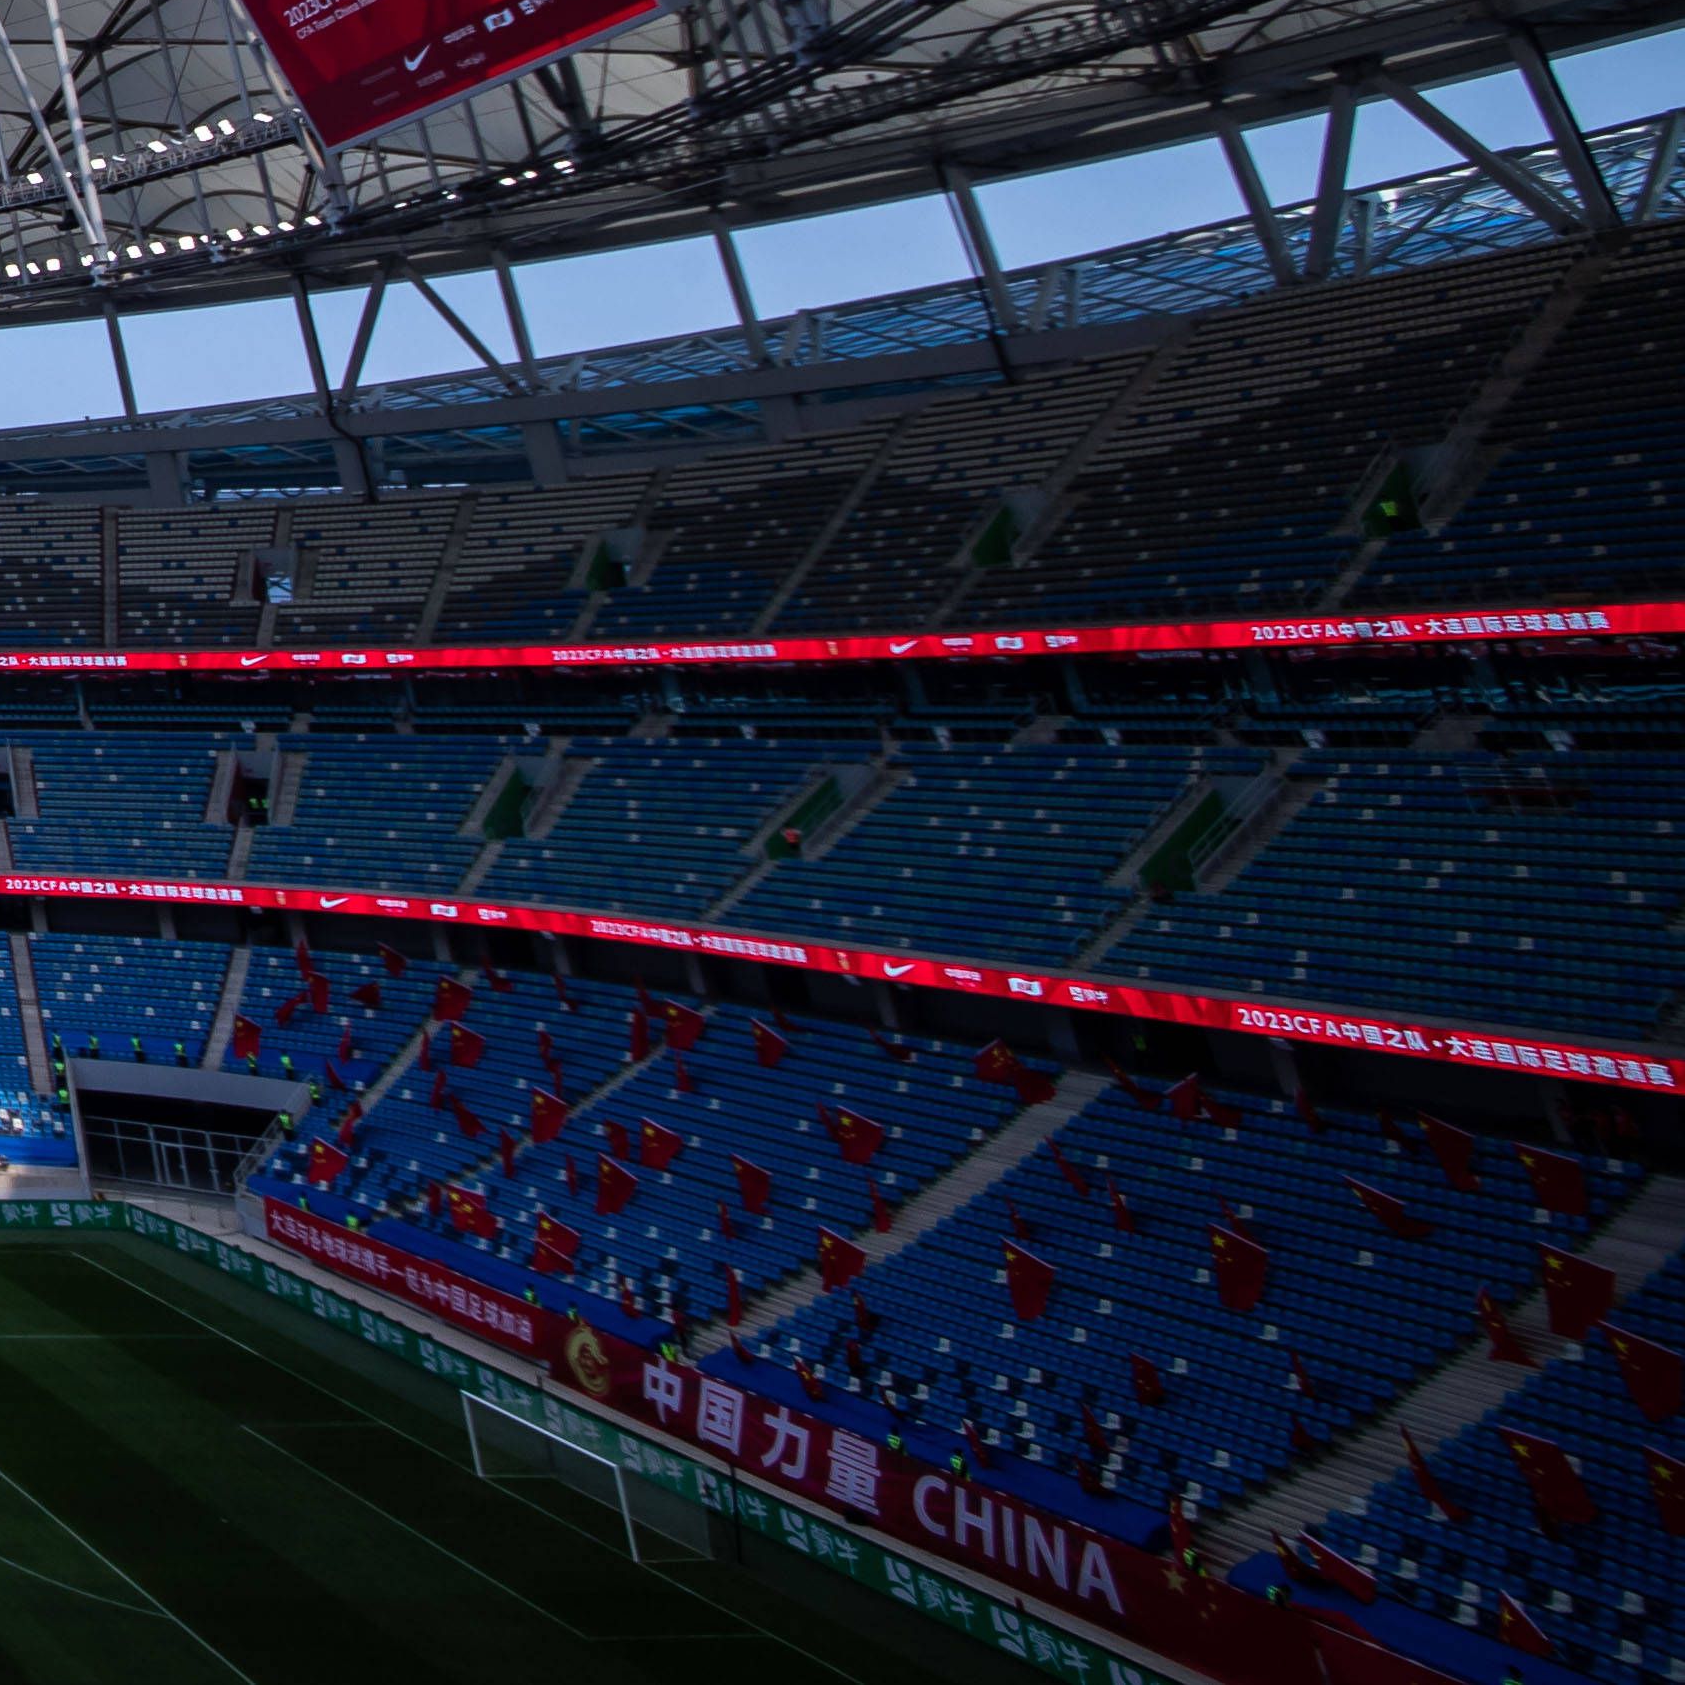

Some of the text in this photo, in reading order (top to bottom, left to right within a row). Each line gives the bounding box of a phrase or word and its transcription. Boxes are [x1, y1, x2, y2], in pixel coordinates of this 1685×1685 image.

[641, 1355, 1125, 1616] 中国力量 CHINA
[809, 1522, 860, 1574] 蒙牛
[917, 1572, 976, 1630] 蒙牛
[1026, 1623, 1091, 1685] 蒙牛
